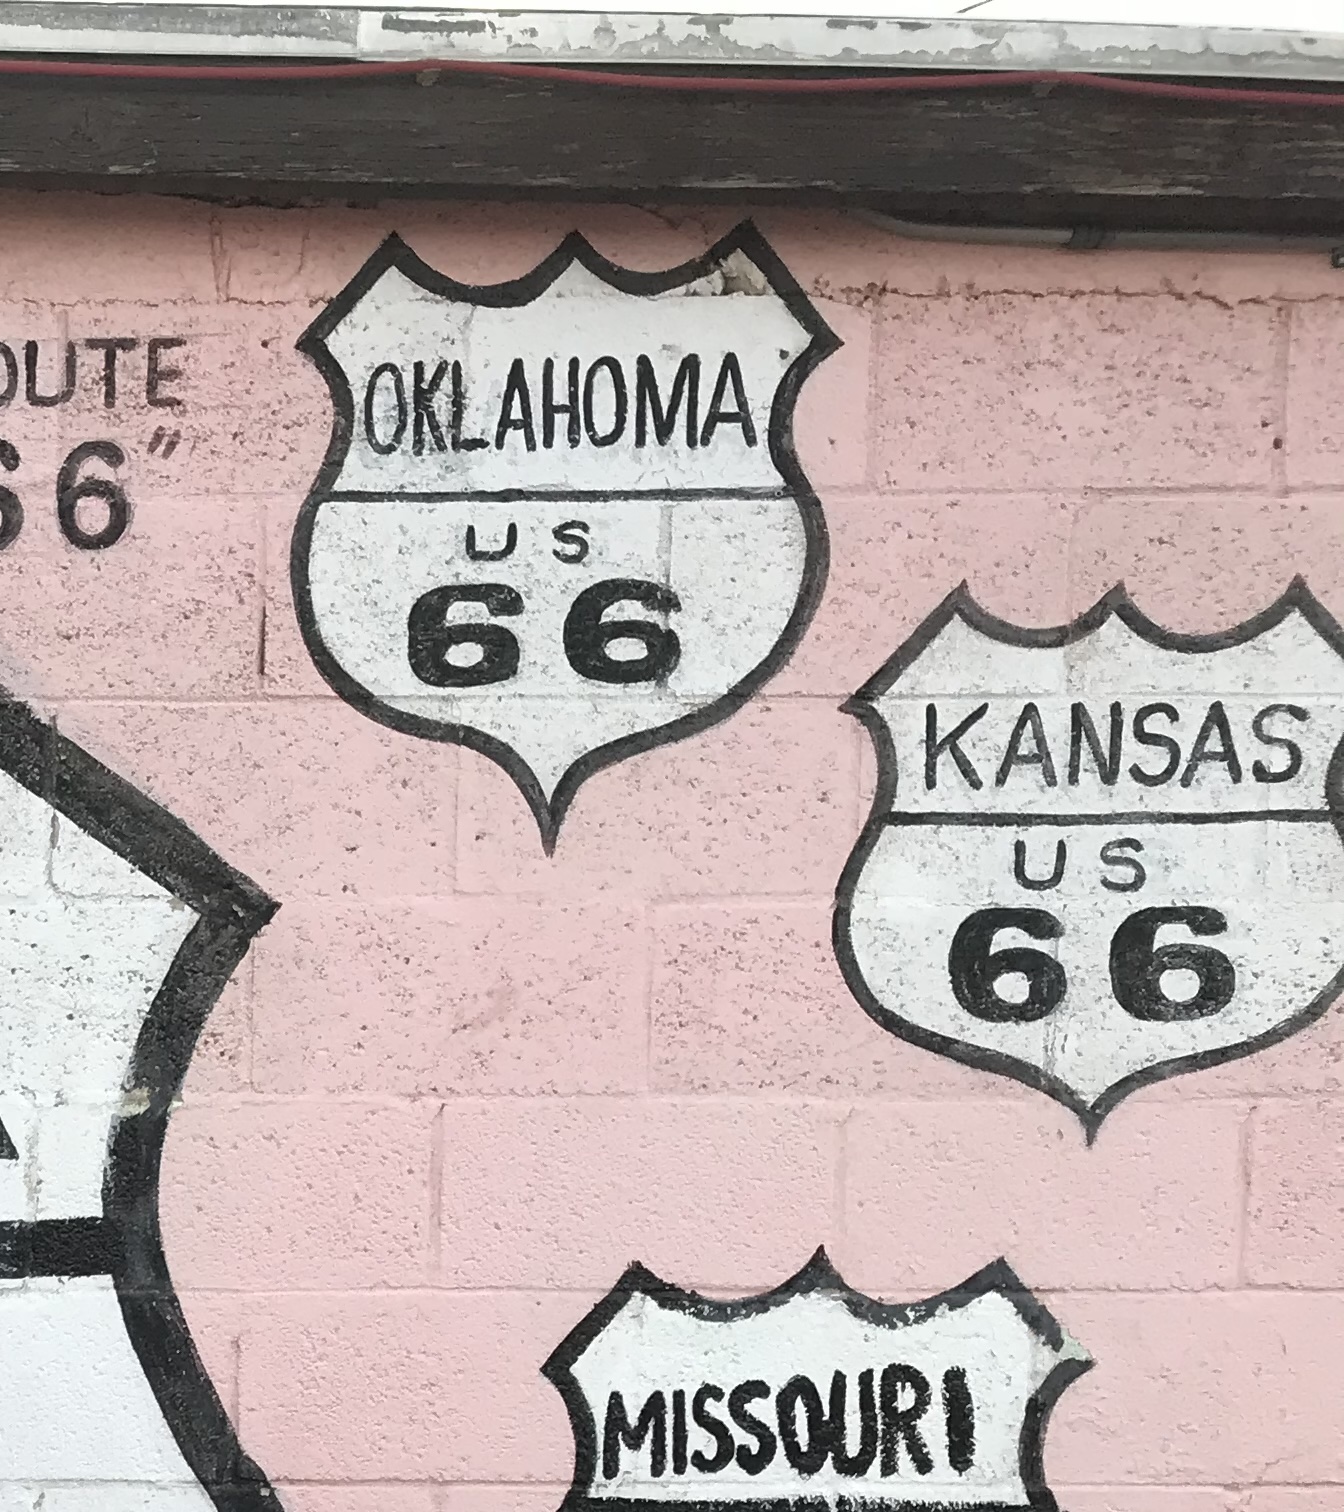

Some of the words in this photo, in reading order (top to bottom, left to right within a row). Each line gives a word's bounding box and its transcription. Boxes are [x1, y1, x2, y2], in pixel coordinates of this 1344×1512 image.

[364, 352, 758, 455] OKLAHOMA
[407, 578, 683, 687] 66
[924, 701, 1311, 791] KANSAS
[948, 905, 1237, 1023] 66
[602, 1363, 977, 1481] MISSOURI
